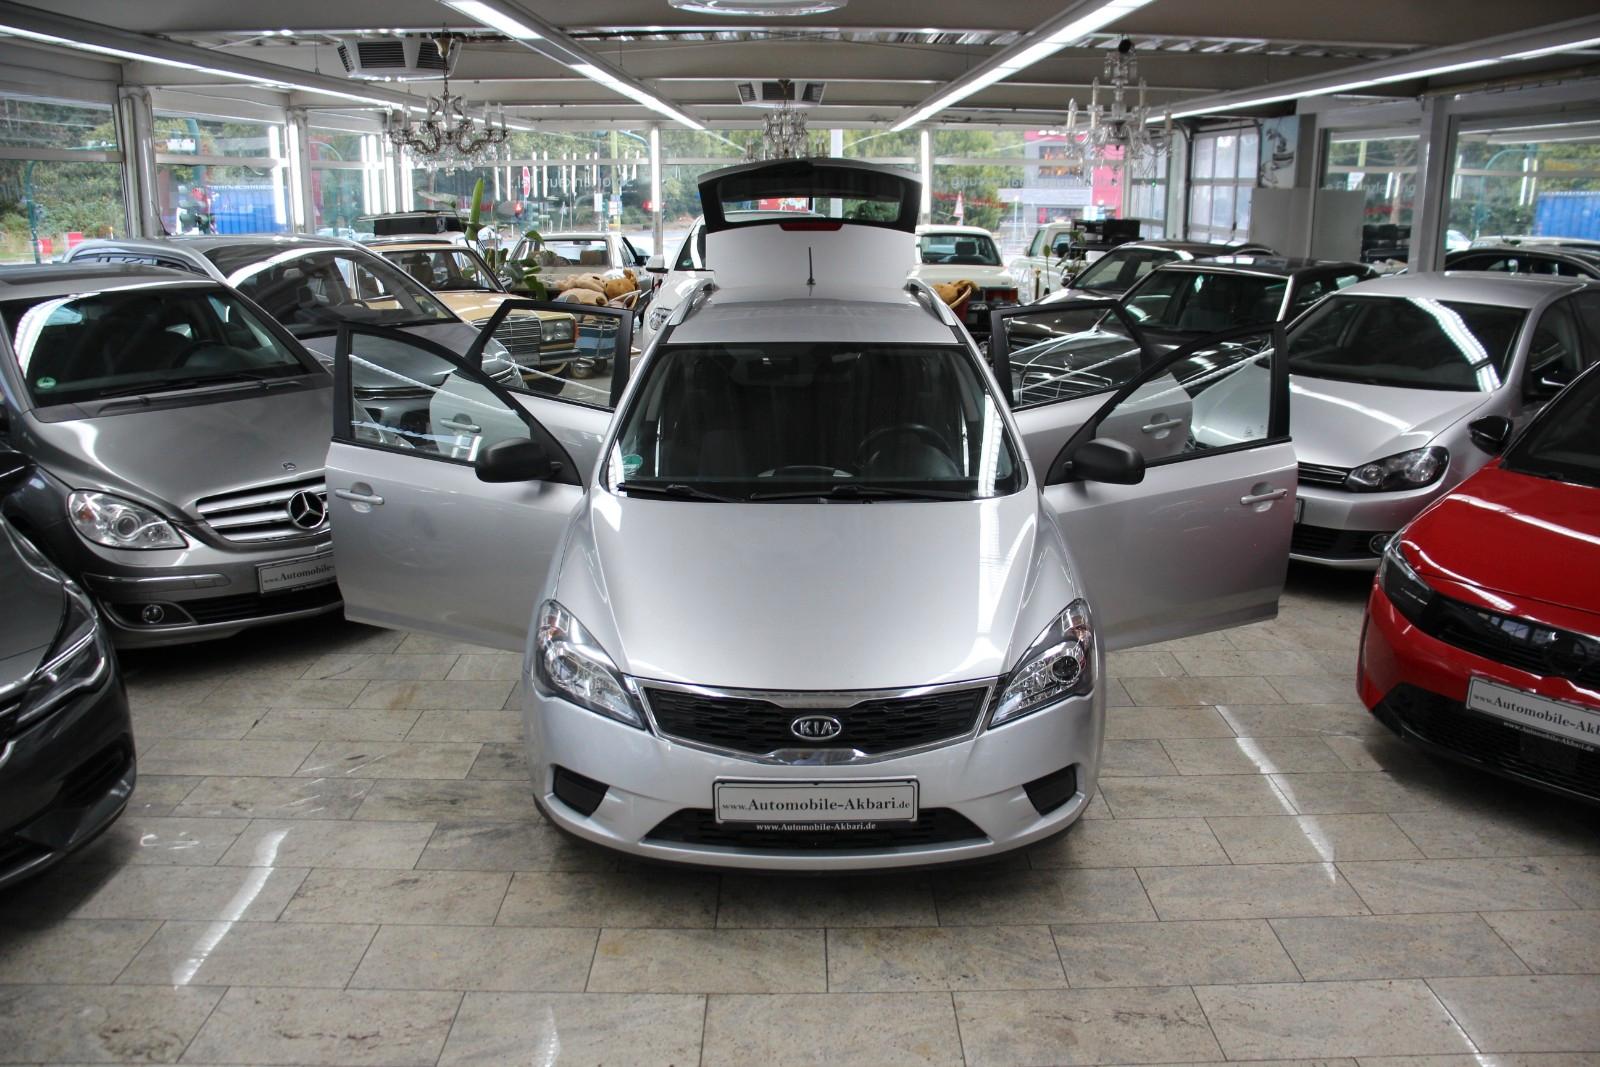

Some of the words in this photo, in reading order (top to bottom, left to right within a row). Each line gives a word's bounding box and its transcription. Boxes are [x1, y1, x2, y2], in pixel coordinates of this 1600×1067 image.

[800, 721, 834, 735] KIA
[722, 797, 910, 811] www.Automobile-Akbari.de
[756, 822, 876, 831] www.Automobile-Akbari.de
